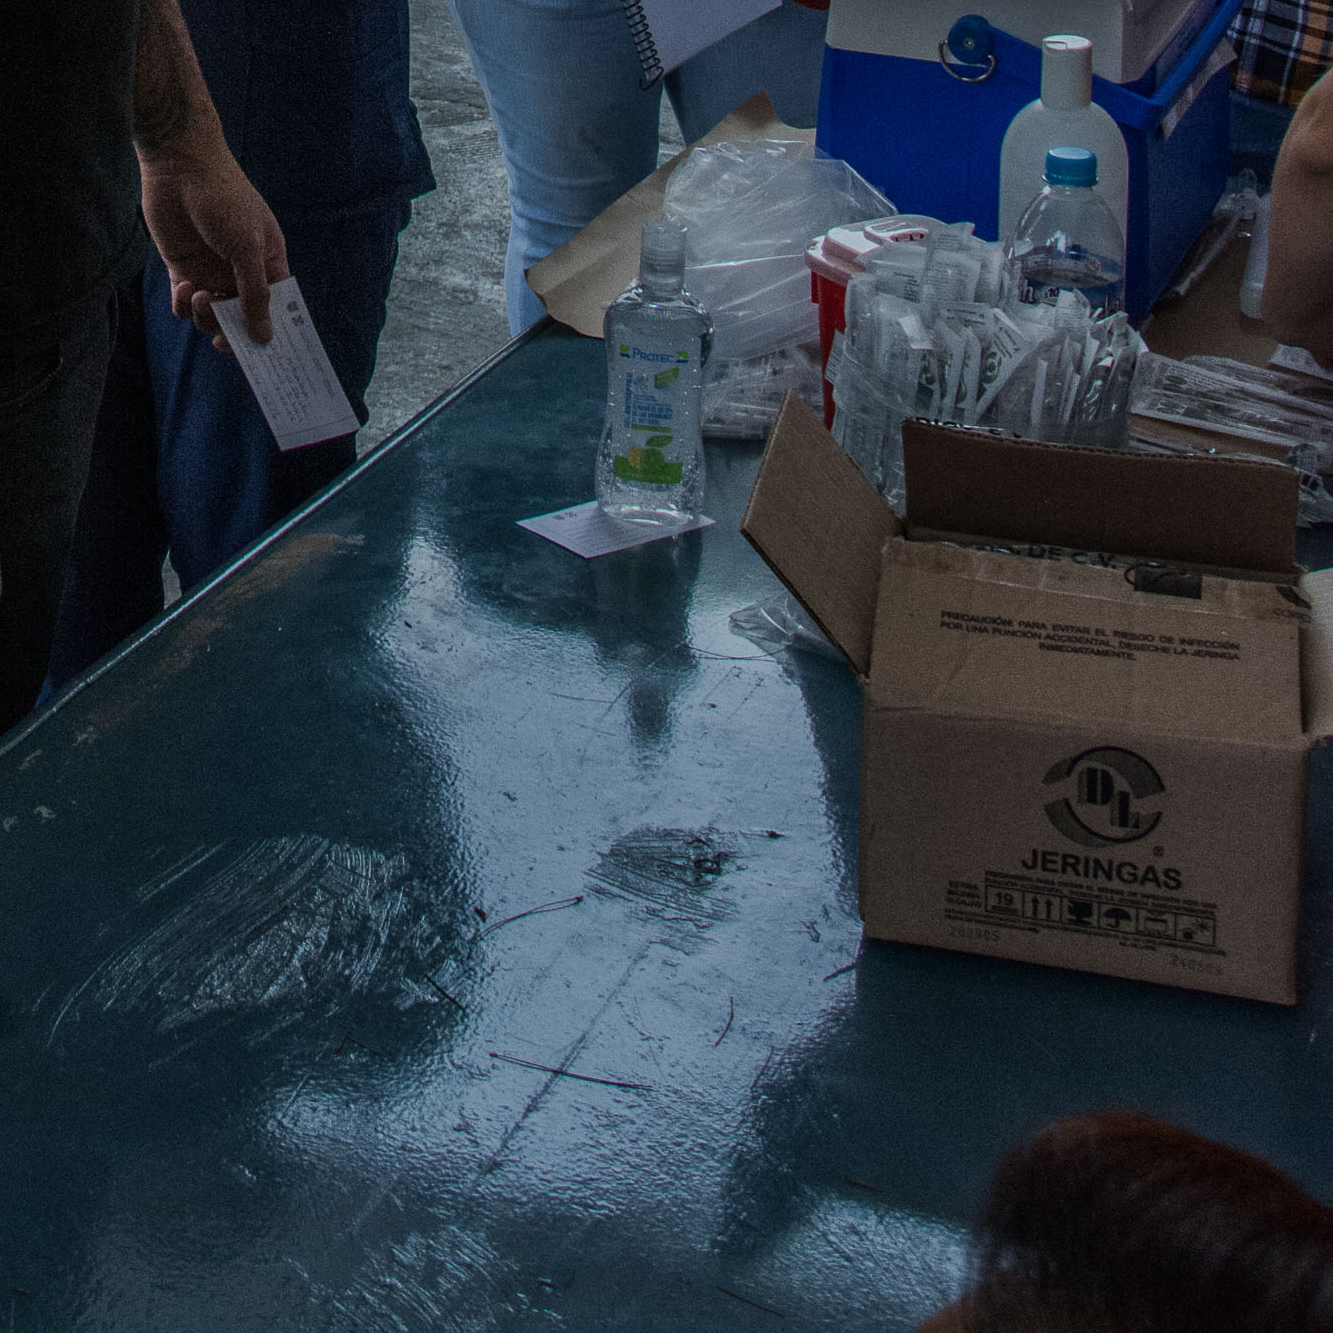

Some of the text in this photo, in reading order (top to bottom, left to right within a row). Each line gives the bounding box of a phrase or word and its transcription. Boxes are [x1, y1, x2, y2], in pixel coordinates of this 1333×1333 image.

[940, 620, 963, 631] POR
[967, 624, 988, 634] UNA
[1119, 641, 1170, 654] DESECHE
[1173, 647, 1188, 656] LA
[1018, 620, 1047, 630] PARA
[1051, 623, 1090, 635] EVITAR
[1095, 627, 1107, 637] EL
[1113, 629, 1154, 642] RIESGO
[1159, 635, 1174, 645] DE
[1022, 849, 1182, 890] JERINGAS
